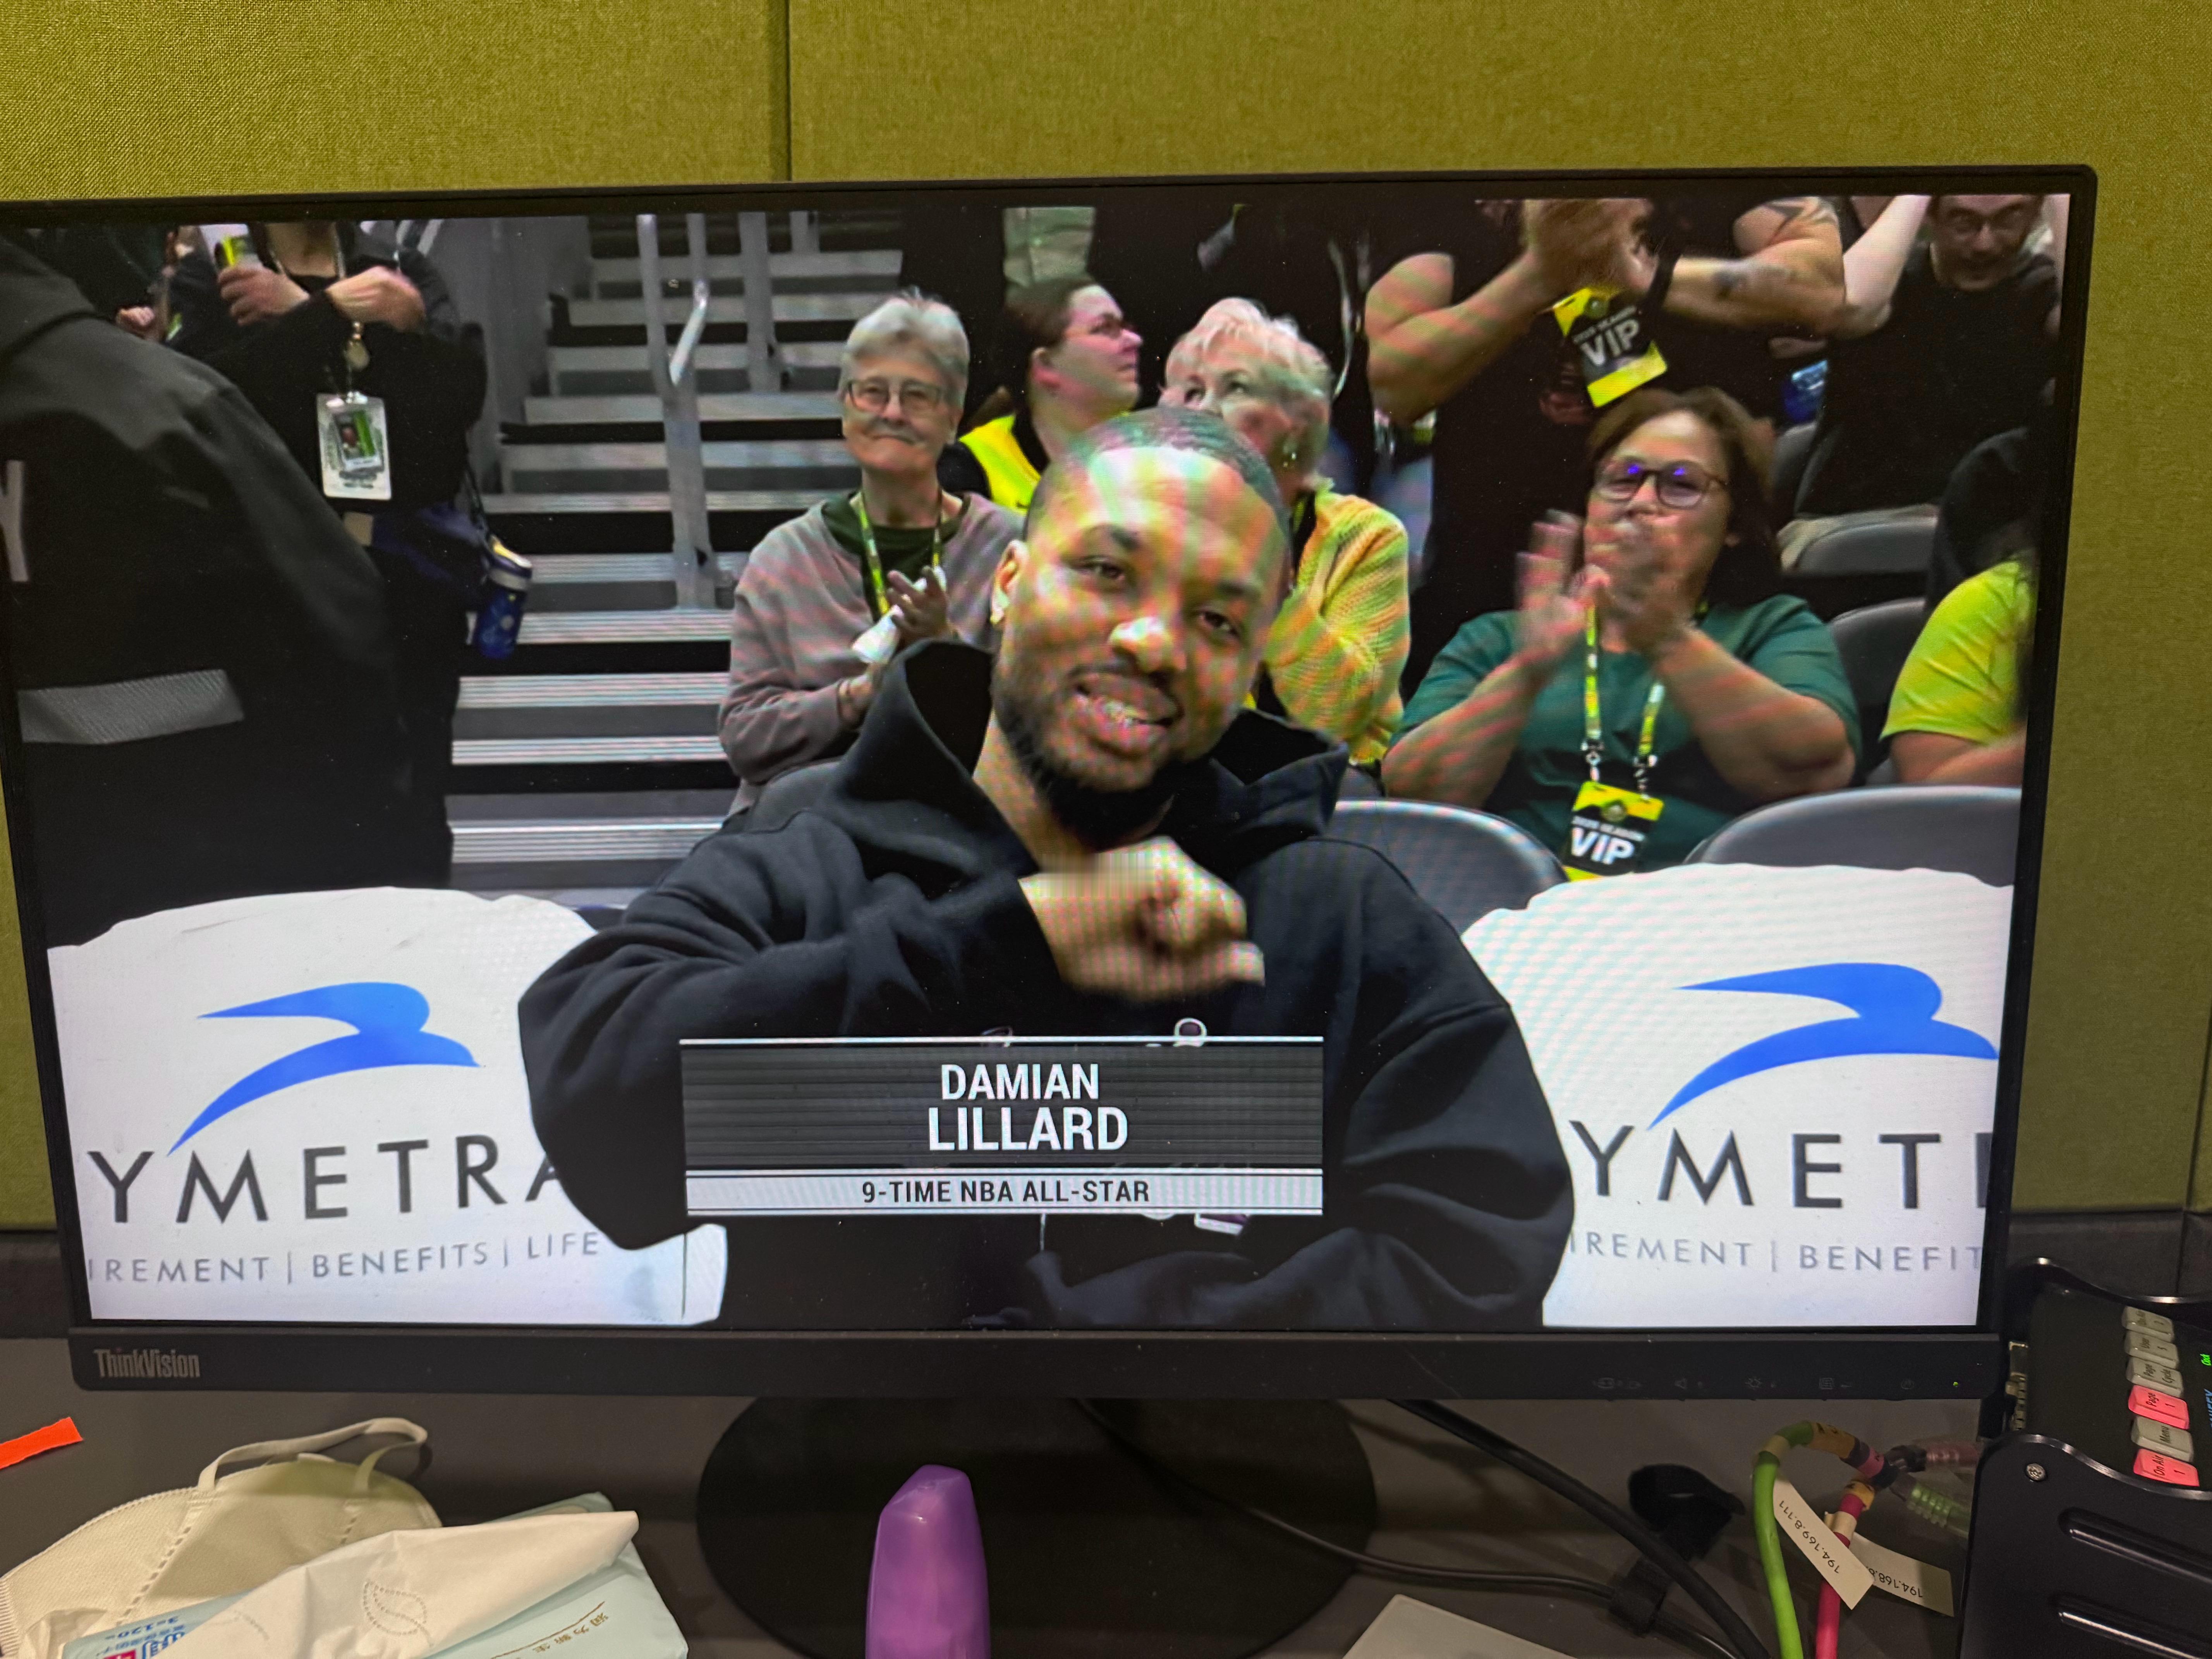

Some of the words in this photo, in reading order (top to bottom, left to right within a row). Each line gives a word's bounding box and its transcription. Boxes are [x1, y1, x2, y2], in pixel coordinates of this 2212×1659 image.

[1580, 318, 1639, 366] VIP
[1571, 826, 1635, 865] VIP
[941, 1063, 1099, 1100] DAMIAN
[928, 1106, 1128, 1151] LILLARD
[1568, 1120, 1993, 1209] YMET
[862, 1180, 952, 1203] 9-TIME
[961, 1180, 1013, 1202] NBA
[1023, 1180, 1150, 1202] ALL-STAR
[88, 1256, 270, 1283] IREMENT
[312, 1242, 488, 1278] BENEFITS
[528, 1231, 598, 1259] LIFE
[1799, 1245, 1982, 1271] BENEFIT
[93, 1348, 200, 1377] ThinkVision
[2143, 1363, 2156, 1378] Page
[2160, 1369, 2175, 1383] Cycle
[2146, 1393, 2159, 1407] Page
[2159, 1425, 2171, 1443] Menu
[2152, 1455, 2164, 1466] Air
[2154, 1466, 2166, 1476] On
[1779, 1500, 1840, 1573] 194.169.8.111
